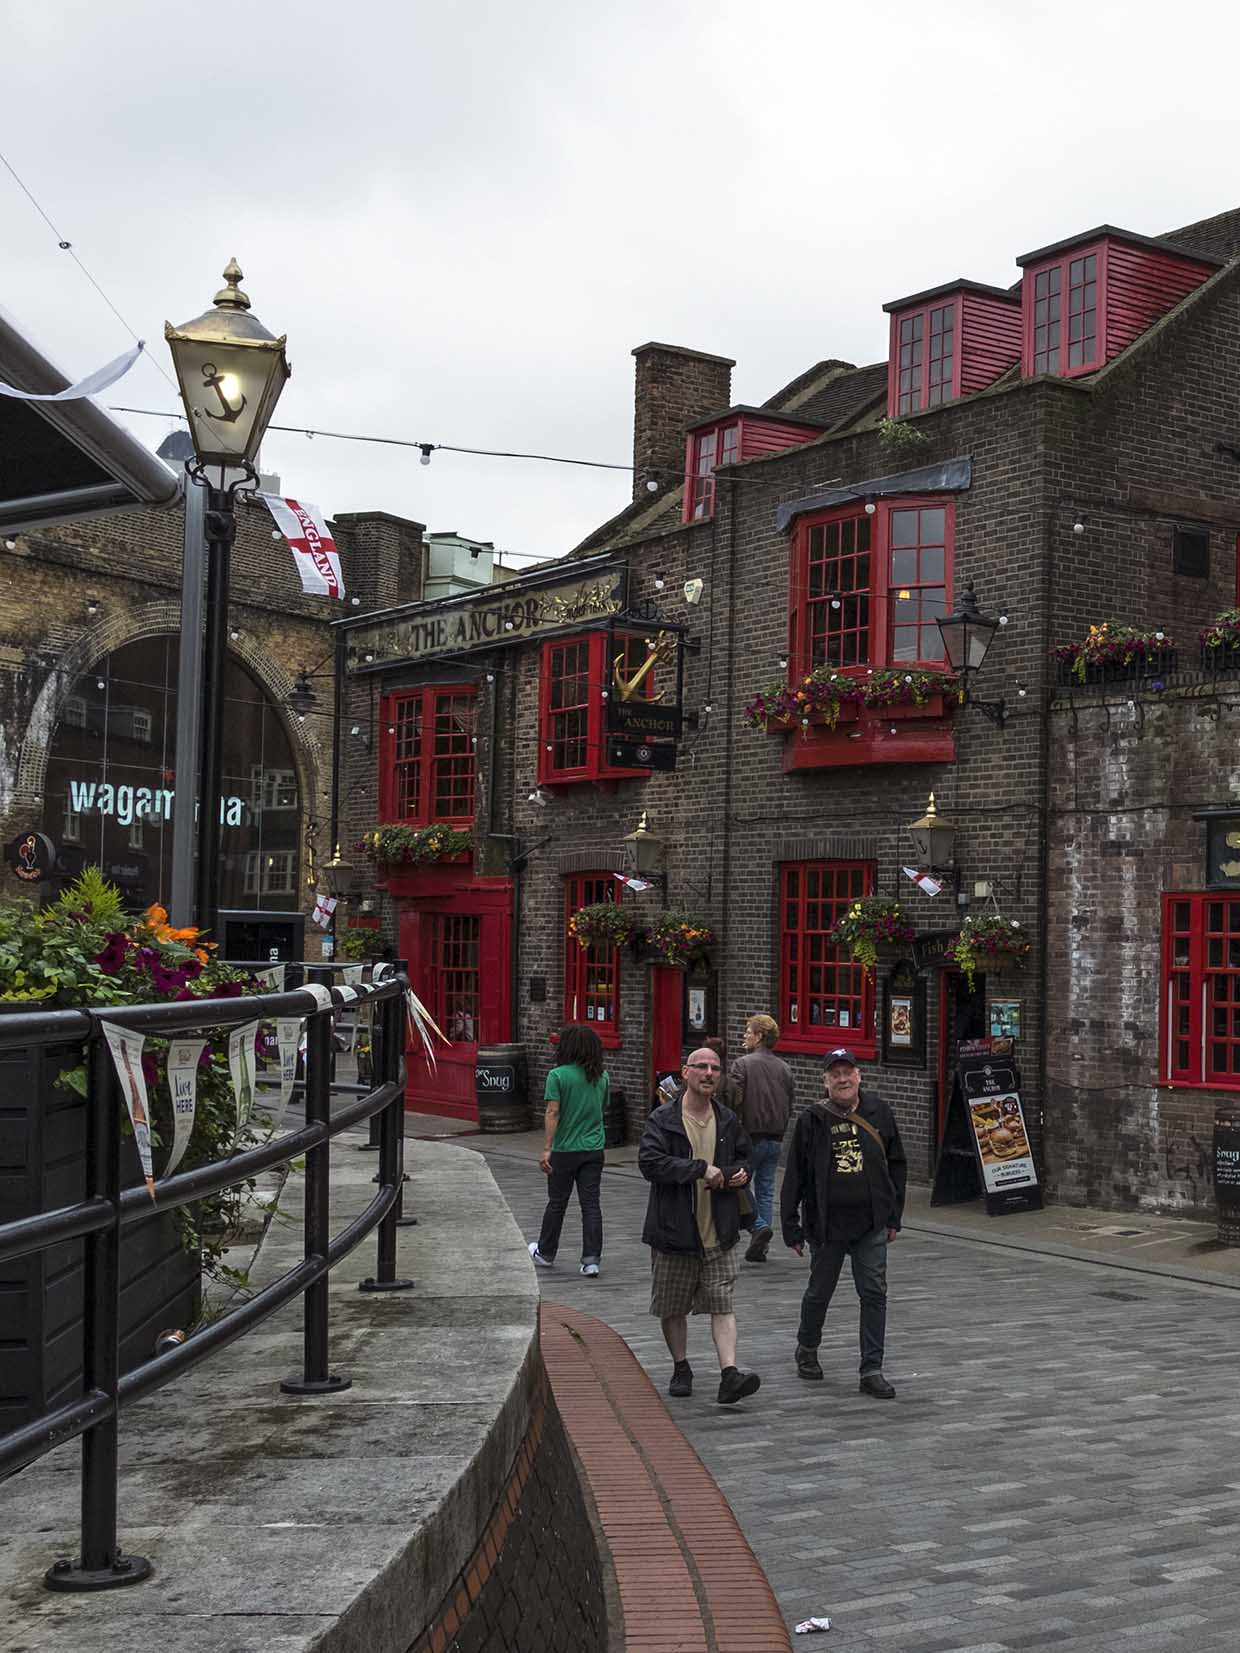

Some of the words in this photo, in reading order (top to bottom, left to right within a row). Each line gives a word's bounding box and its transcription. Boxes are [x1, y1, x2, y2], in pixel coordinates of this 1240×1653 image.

[295, 509, 337, 587] ENGLAND
[411, 619, 449, 651] THE
[455, 599, 540, 643] ANCHOR
[69, 780, 243, 826] wagama
[482, 1069, 510, 1091] Snug
[176, 1099, 193, 1113] HERE
